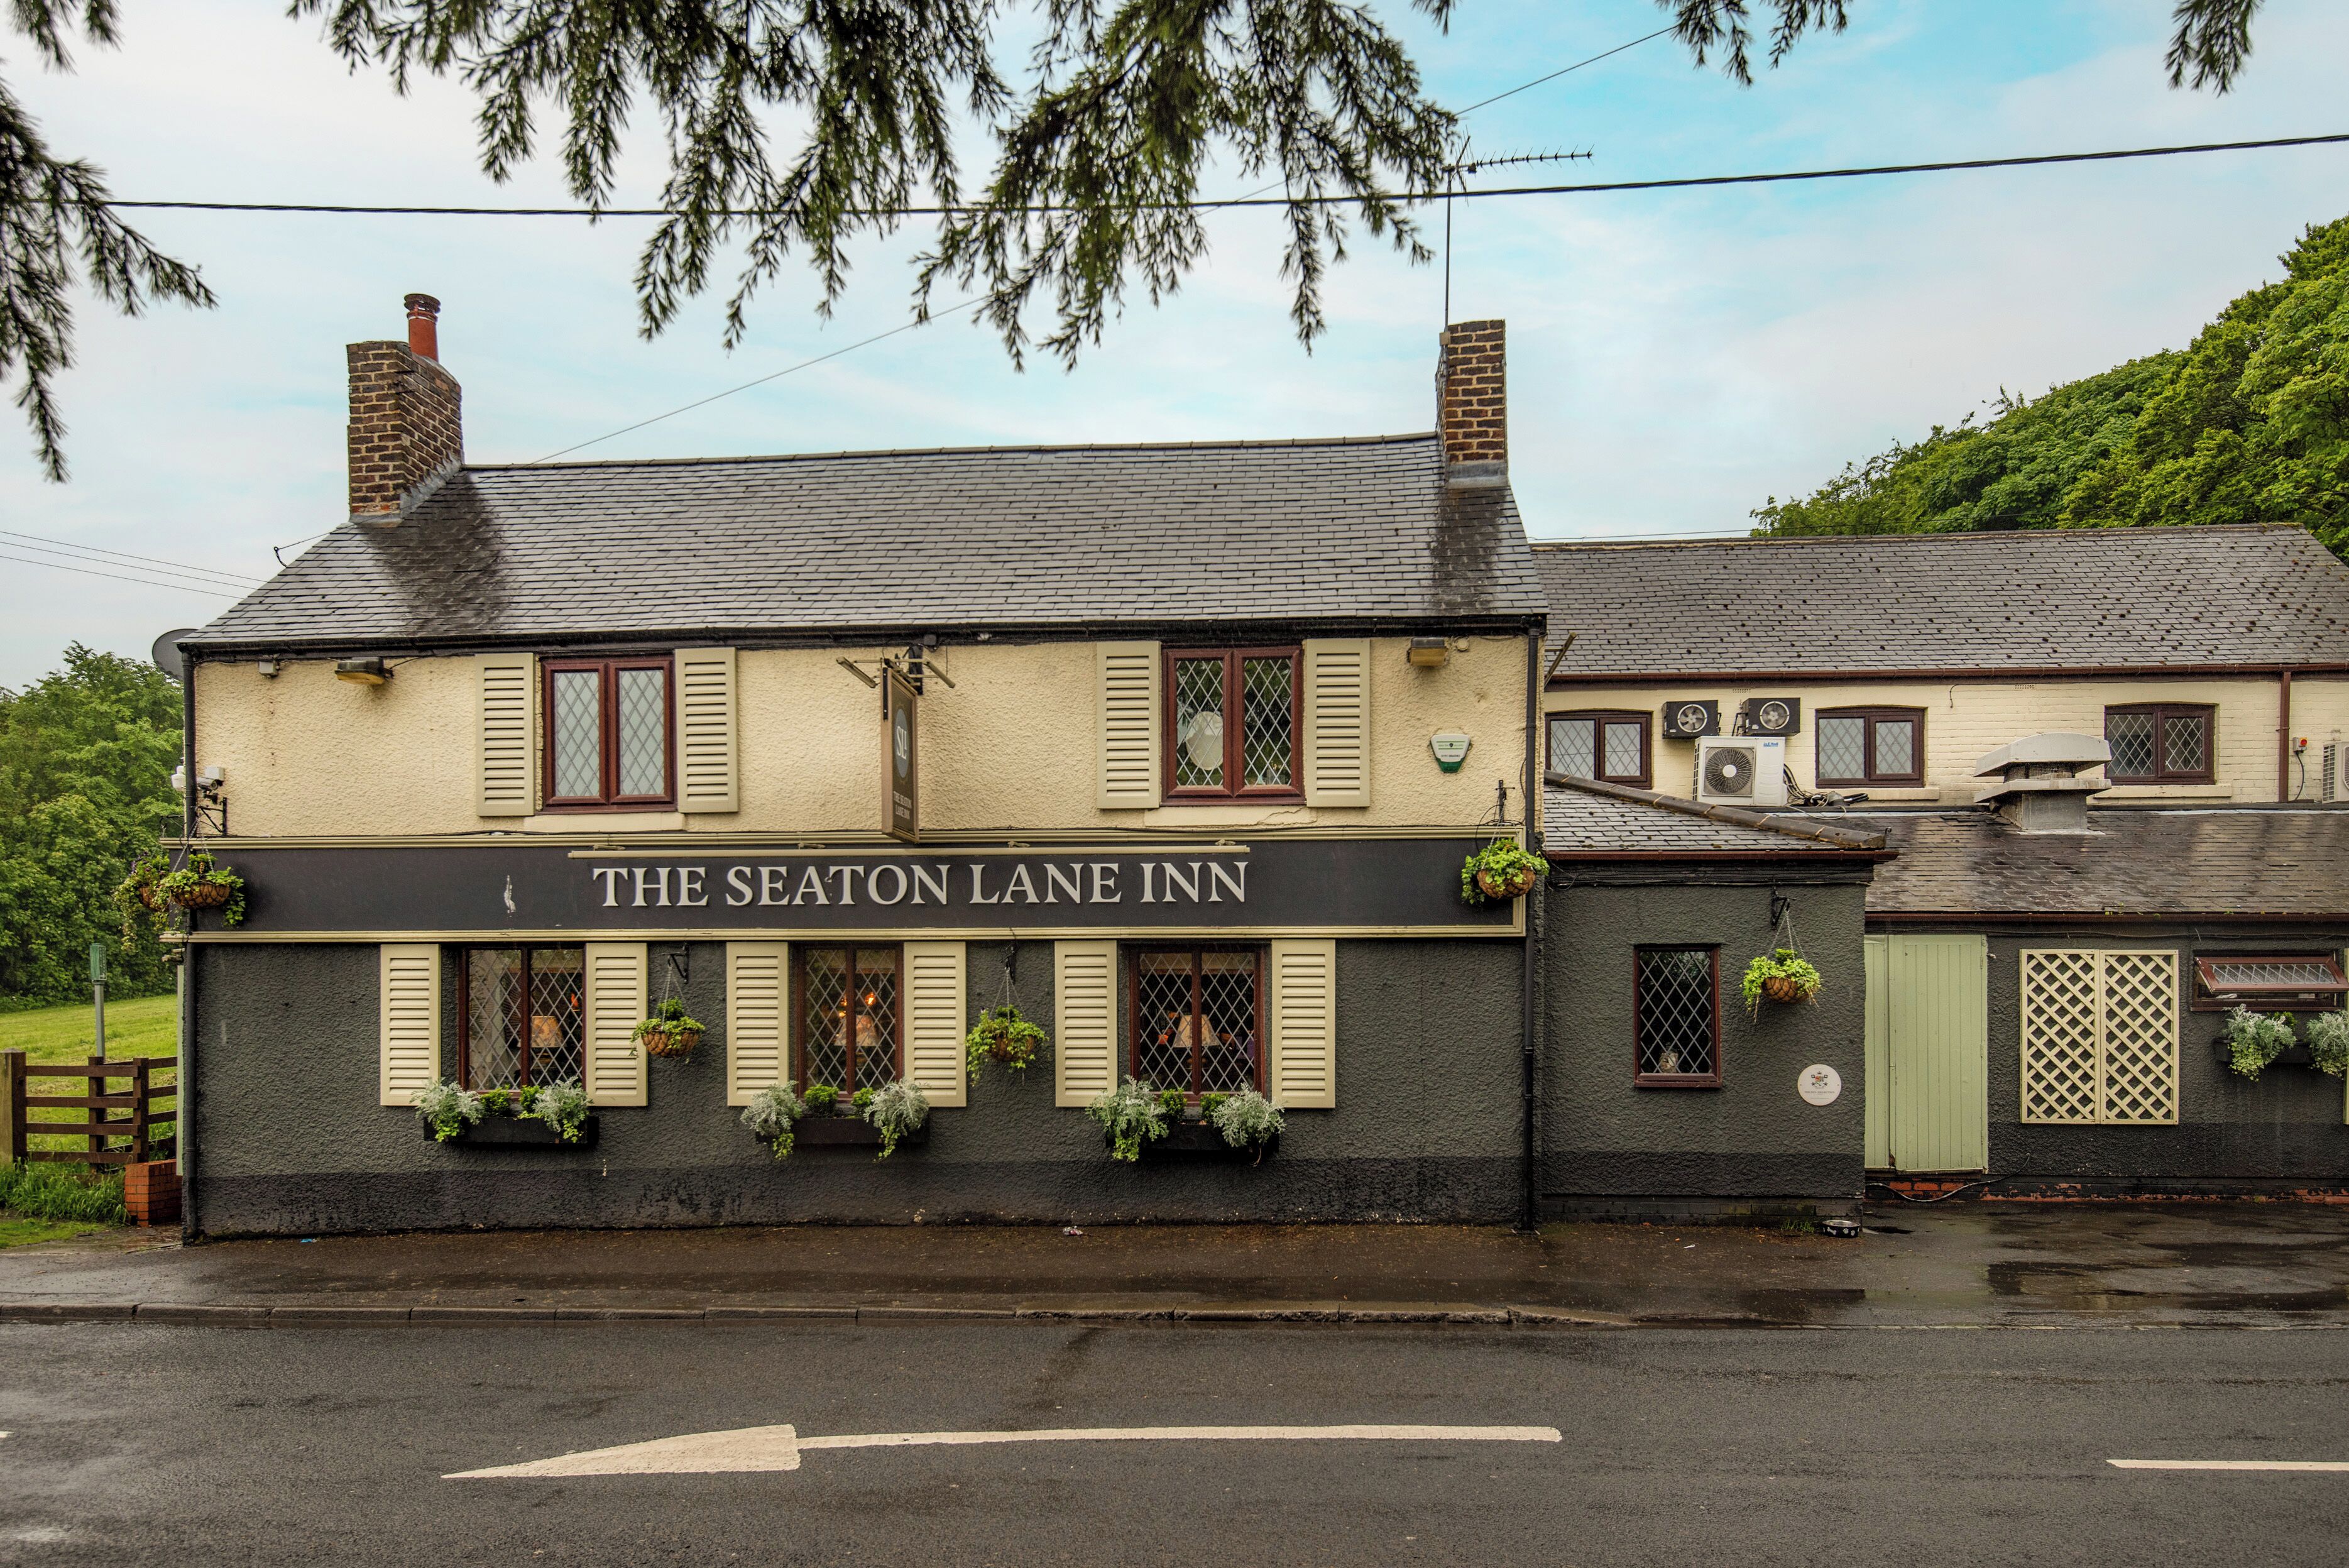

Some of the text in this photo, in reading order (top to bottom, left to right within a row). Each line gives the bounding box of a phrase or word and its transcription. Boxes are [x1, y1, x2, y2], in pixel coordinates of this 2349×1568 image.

[593, 861, 1250, 907] THE SEATON LANE INN
